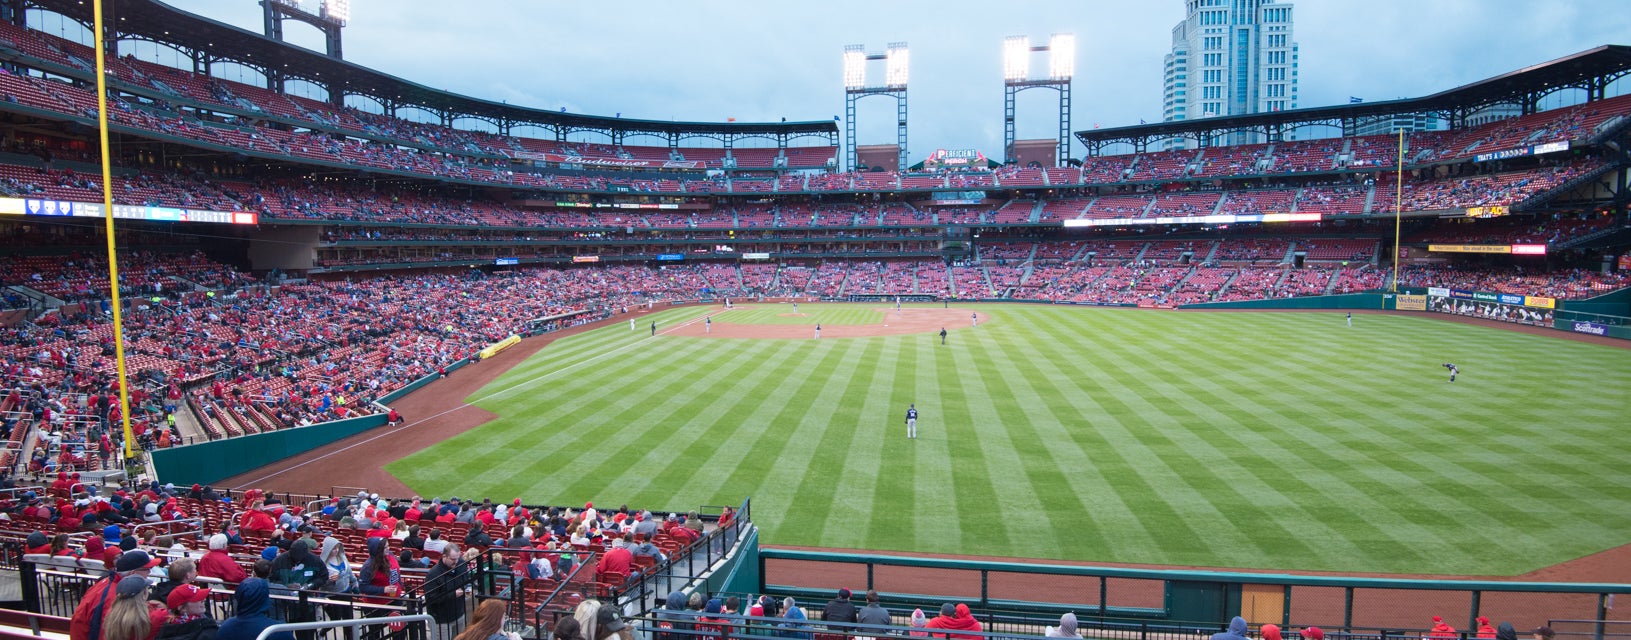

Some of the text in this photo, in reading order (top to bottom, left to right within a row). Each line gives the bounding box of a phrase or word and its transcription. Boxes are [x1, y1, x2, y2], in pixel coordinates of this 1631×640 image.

[937, 149, 976, 160] PERFICIENT
[1477, 153, 1493, 162] THAT'S
[565, 156, 649, 167] Budweiser
[1574, 322, 1605, 335] Scottrade
